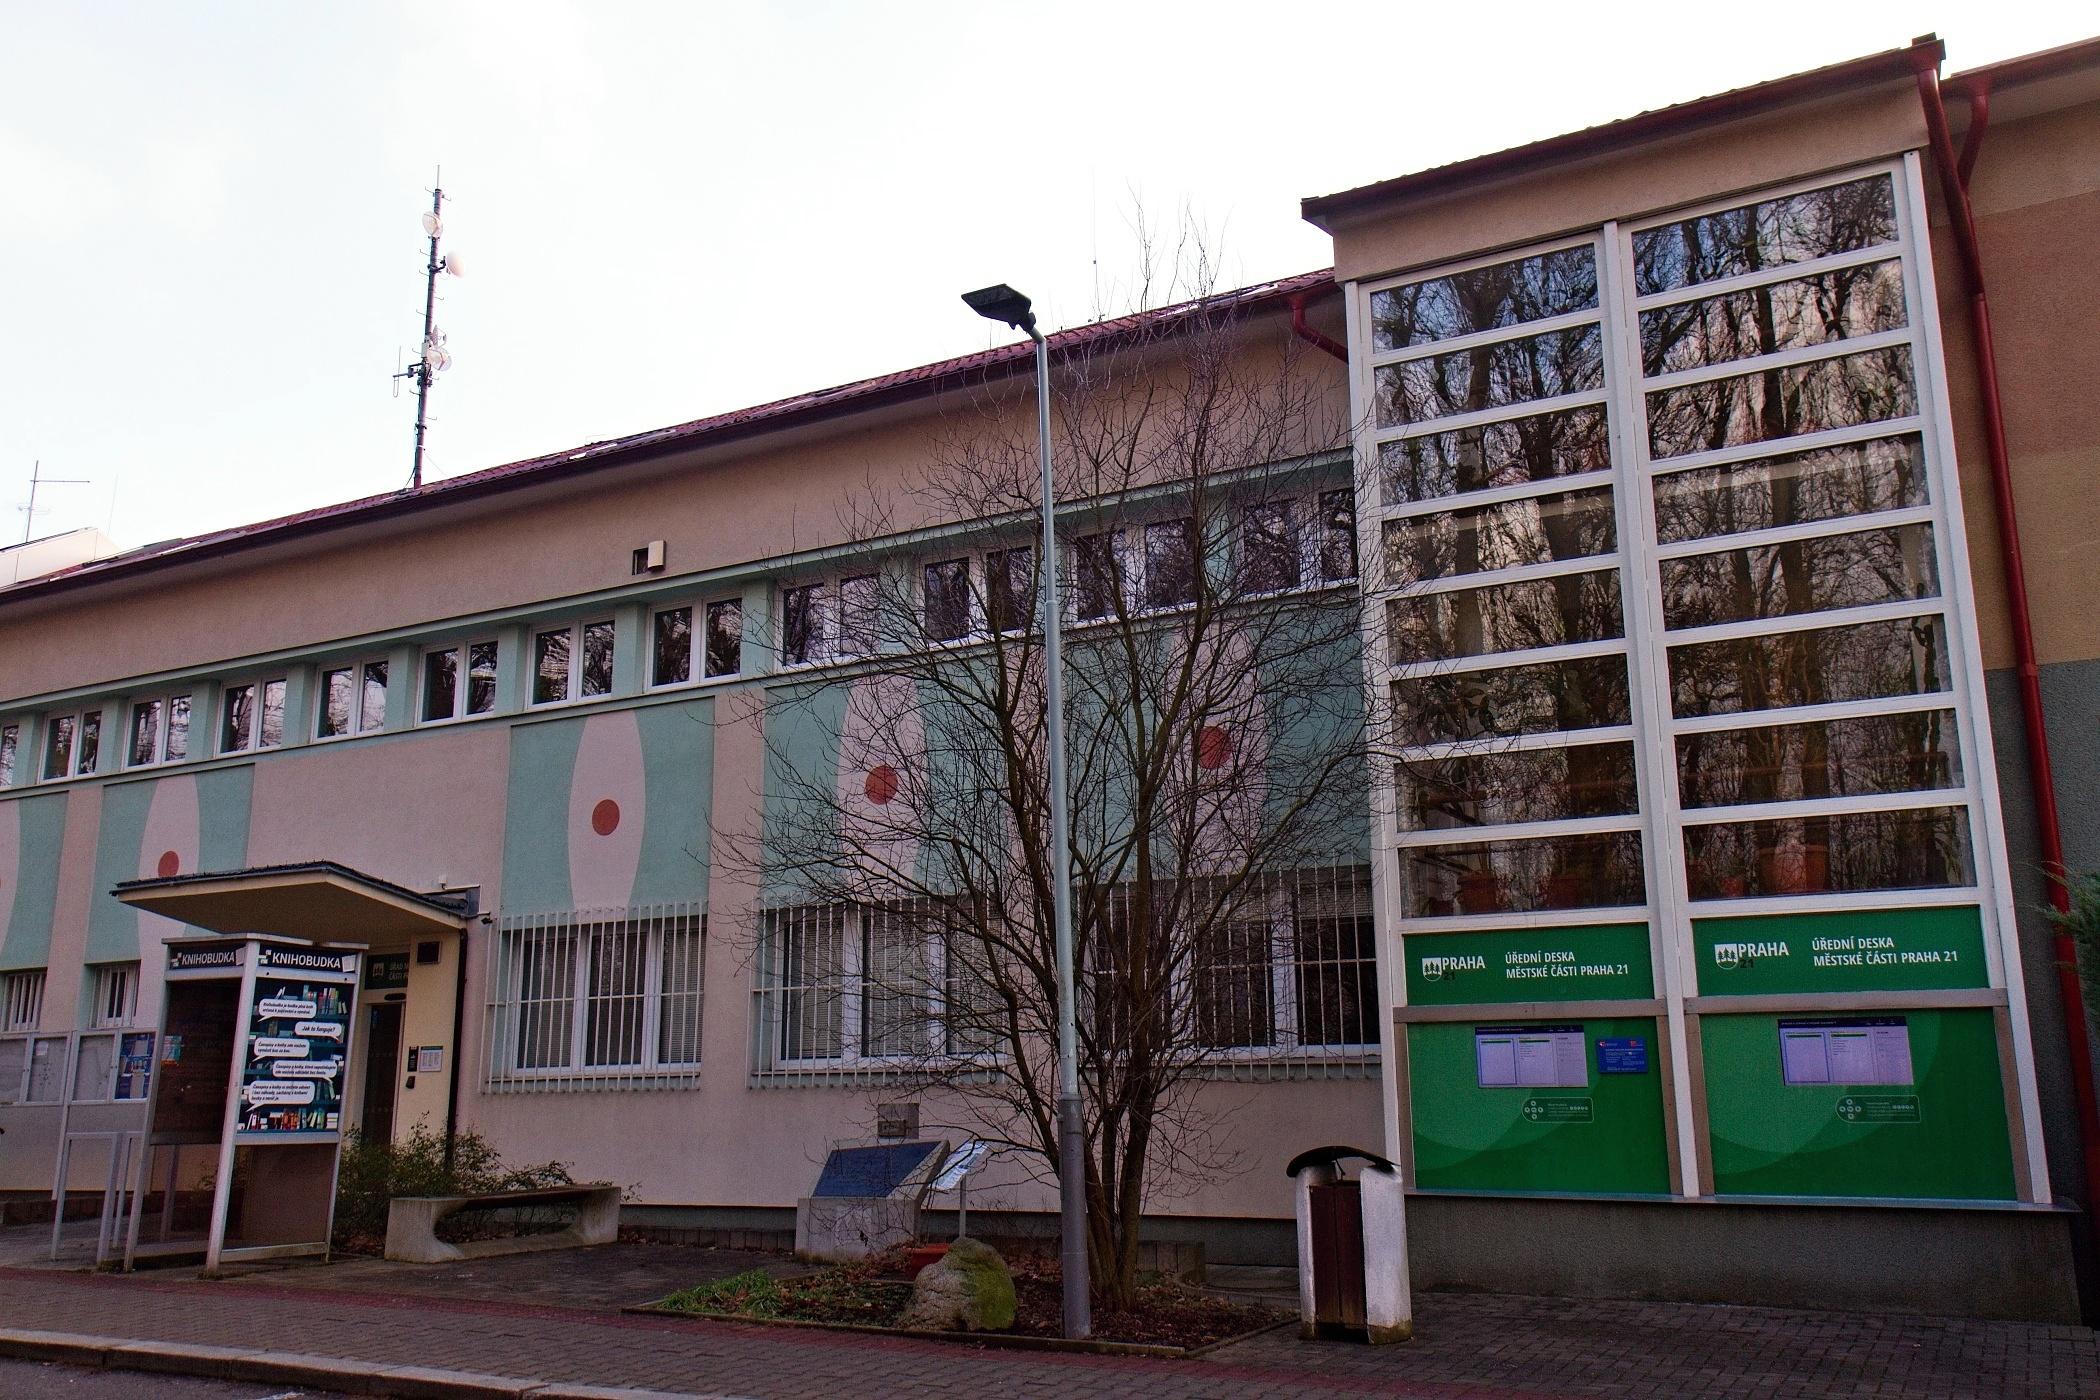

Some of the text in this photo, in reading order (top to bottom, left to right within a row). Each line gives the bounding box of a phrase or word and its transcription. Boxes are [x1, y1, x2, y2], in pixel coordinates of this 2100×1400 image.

[1738, 941, 1789, 958] PRAHA
[1812, 936, 1894, 951] ÚŘEDNÍ DESKA
[181, 951, 235, 966] KNIHOBUDKA
[272, 952, 341, 968] KNIHOBUDKA
[1442, 956, 1486, 970] PRAHA
[1505, 950, 1575, 964] ÚŘEDNÍ DESKA
[1739, 958, 1754, 969] 21
[1813, 950, 1958, 967] MĚSTSKÉ ČÁSTI PRAHA 21
[1443, 972, 1455, 980] 21
[1506, 964, 1628, 979] MĚSTSKÉ ČÁSTI PRAHA 21
